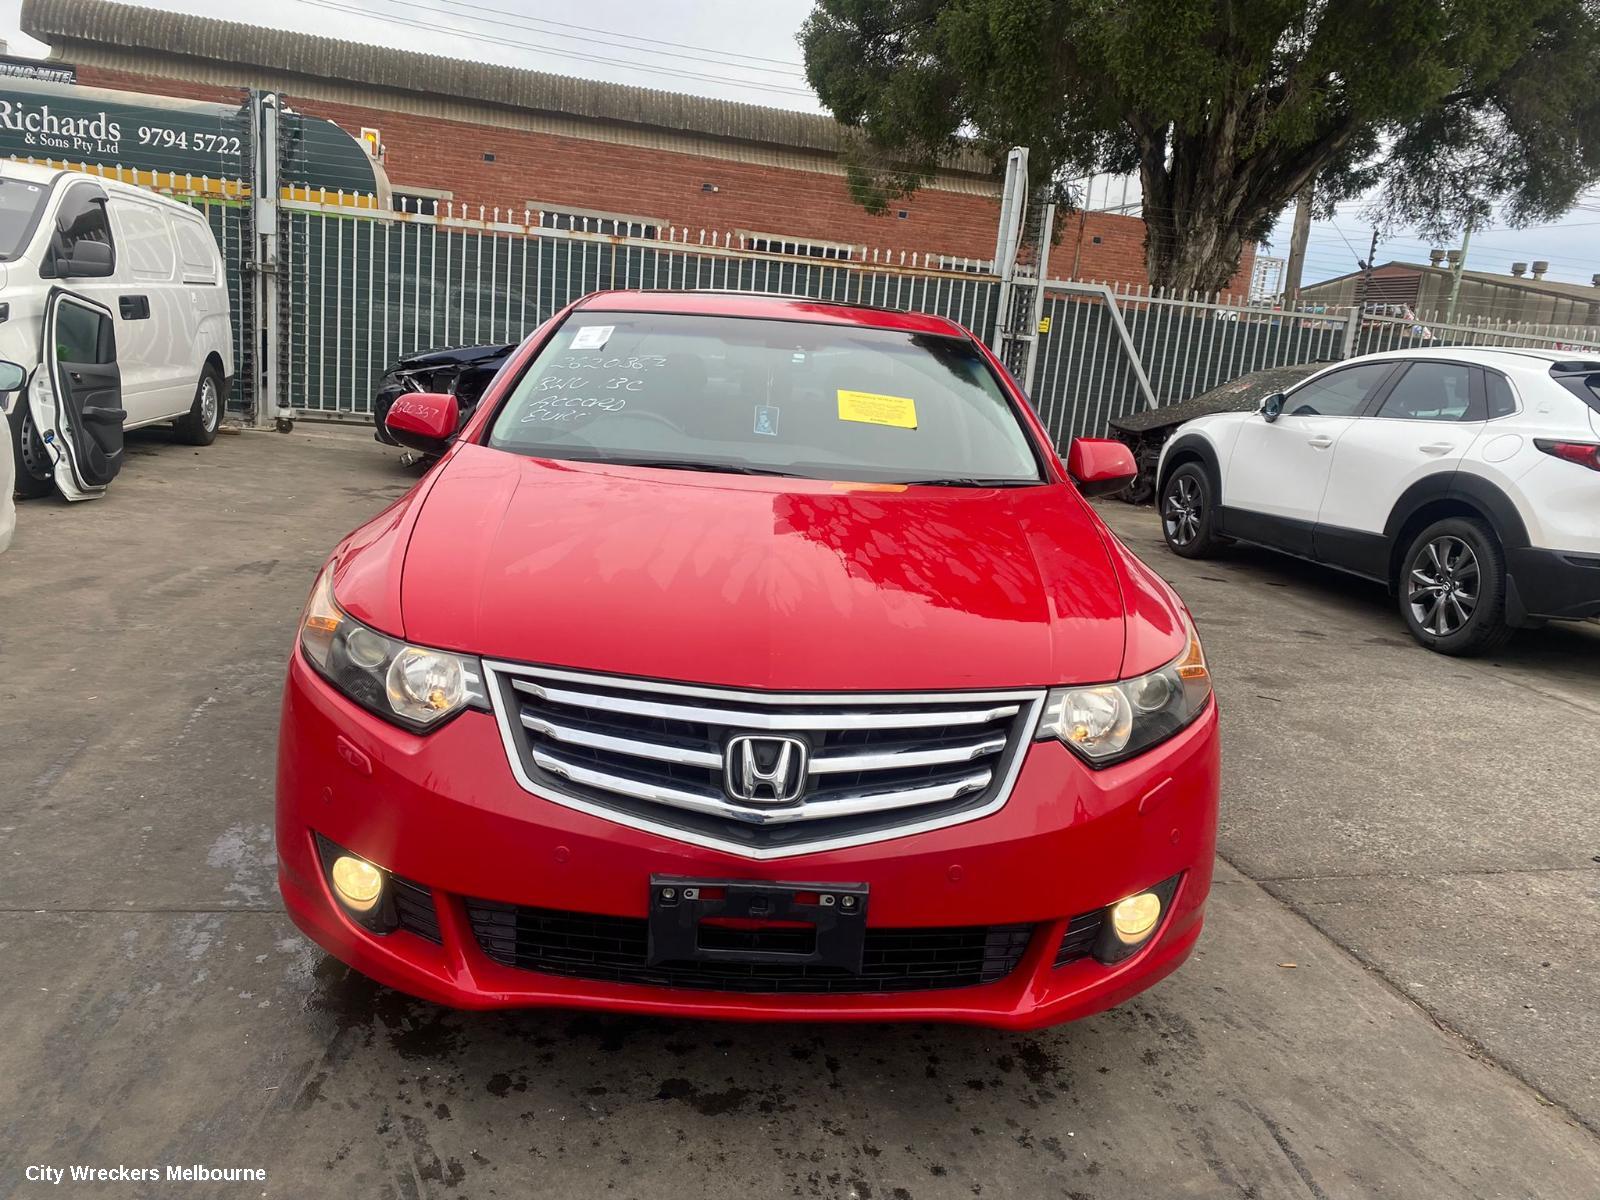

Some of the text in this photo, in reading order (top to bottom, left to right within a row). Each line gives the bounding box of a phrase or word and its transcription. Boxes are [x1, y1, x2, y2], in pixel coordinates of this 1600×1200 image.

[0, 100, 121, 142] Richards
[24, 132, 119, 155] & Sons Pty Ltd
[138, 126, 241, 156] 9794 5722
